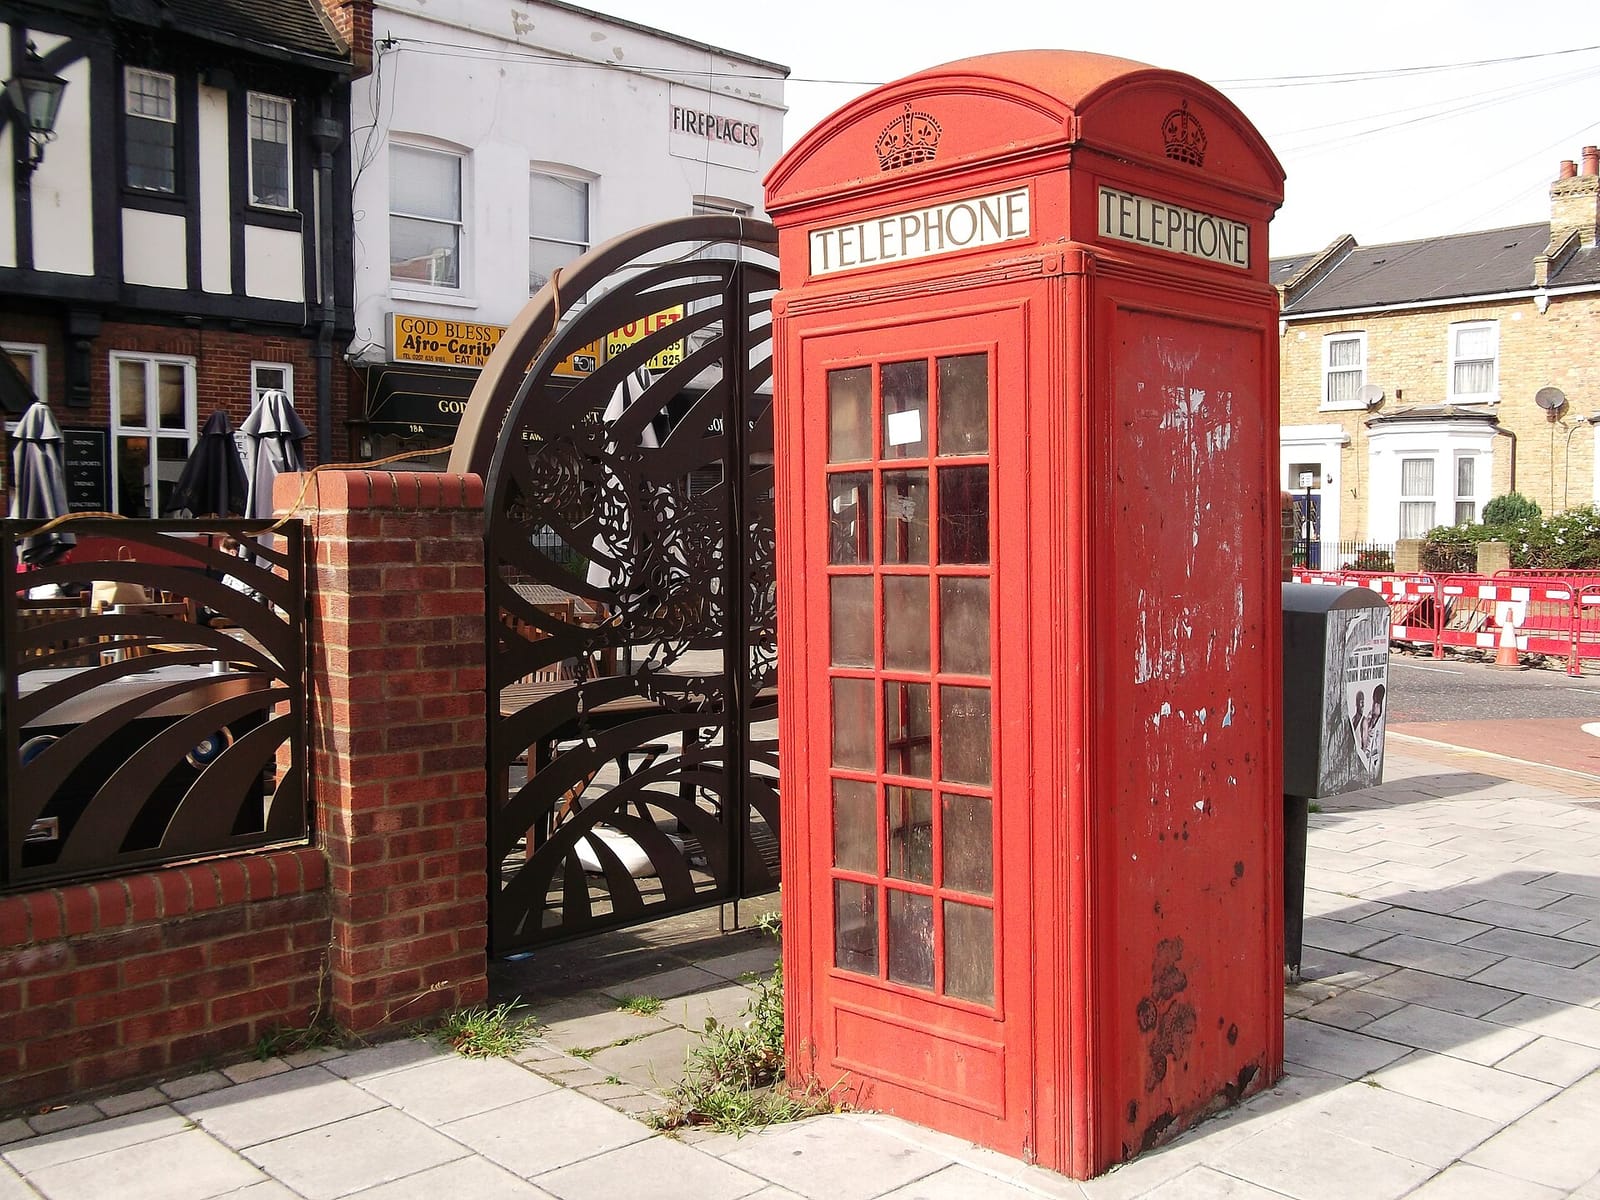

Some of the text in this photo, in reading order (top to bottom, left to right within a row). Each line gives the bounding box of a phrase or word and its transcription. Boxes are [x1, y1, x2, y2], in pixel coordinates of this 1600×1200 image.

[673, 107, 758, 147] FIREPLACES
[815, 192, 1027, 270] TELEPHONE
[1100, 190, 1246, 265] TELEPHONE
[401, 318, 439, 336] GOD
[445, 323, 491, 341] BLESS
[454, 355, 484, 365] EAT IN
[662, 354, 680, 366] 825
[409, 424, 424, 433] 18A
